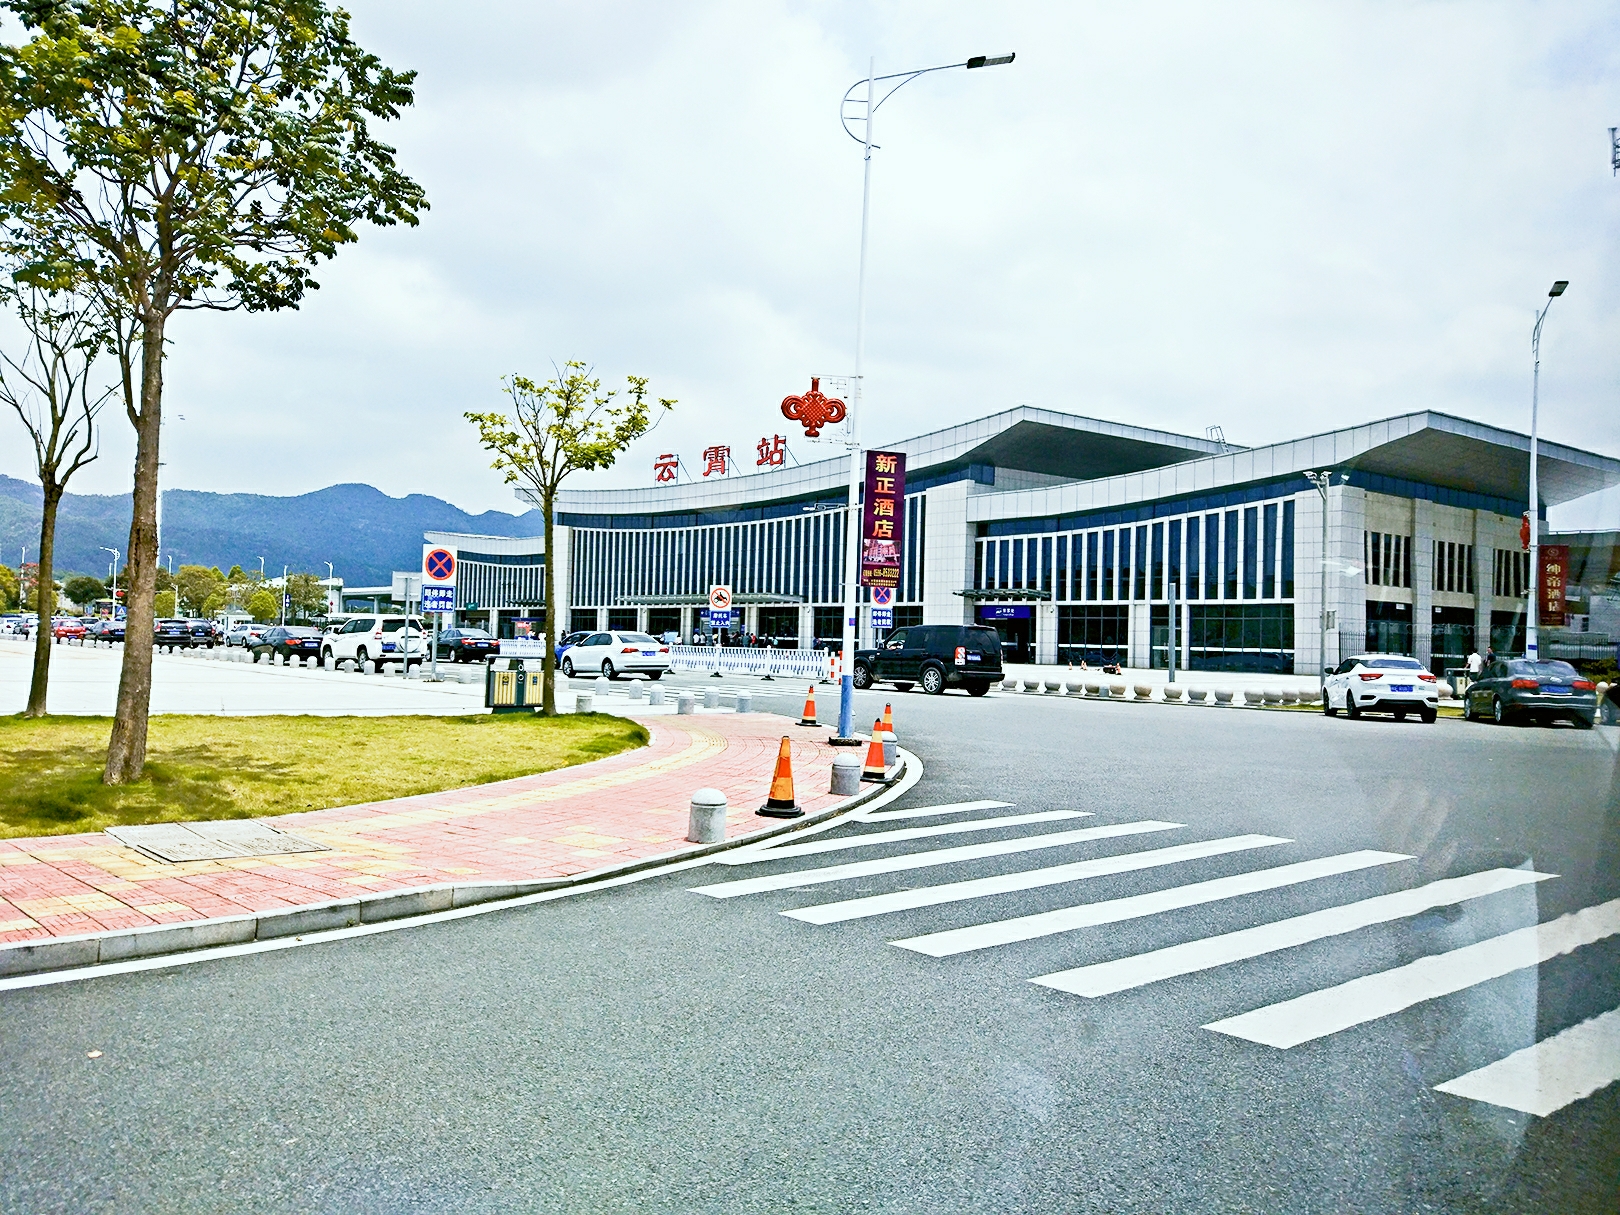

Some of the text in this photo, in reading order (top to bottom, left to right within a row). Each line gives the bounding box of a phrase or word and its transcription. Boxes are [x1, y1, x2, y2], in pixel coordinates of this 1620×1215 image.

[654, 434, 786, 481] 云霄站
[872, 454, 897, 537] 新正酒店
